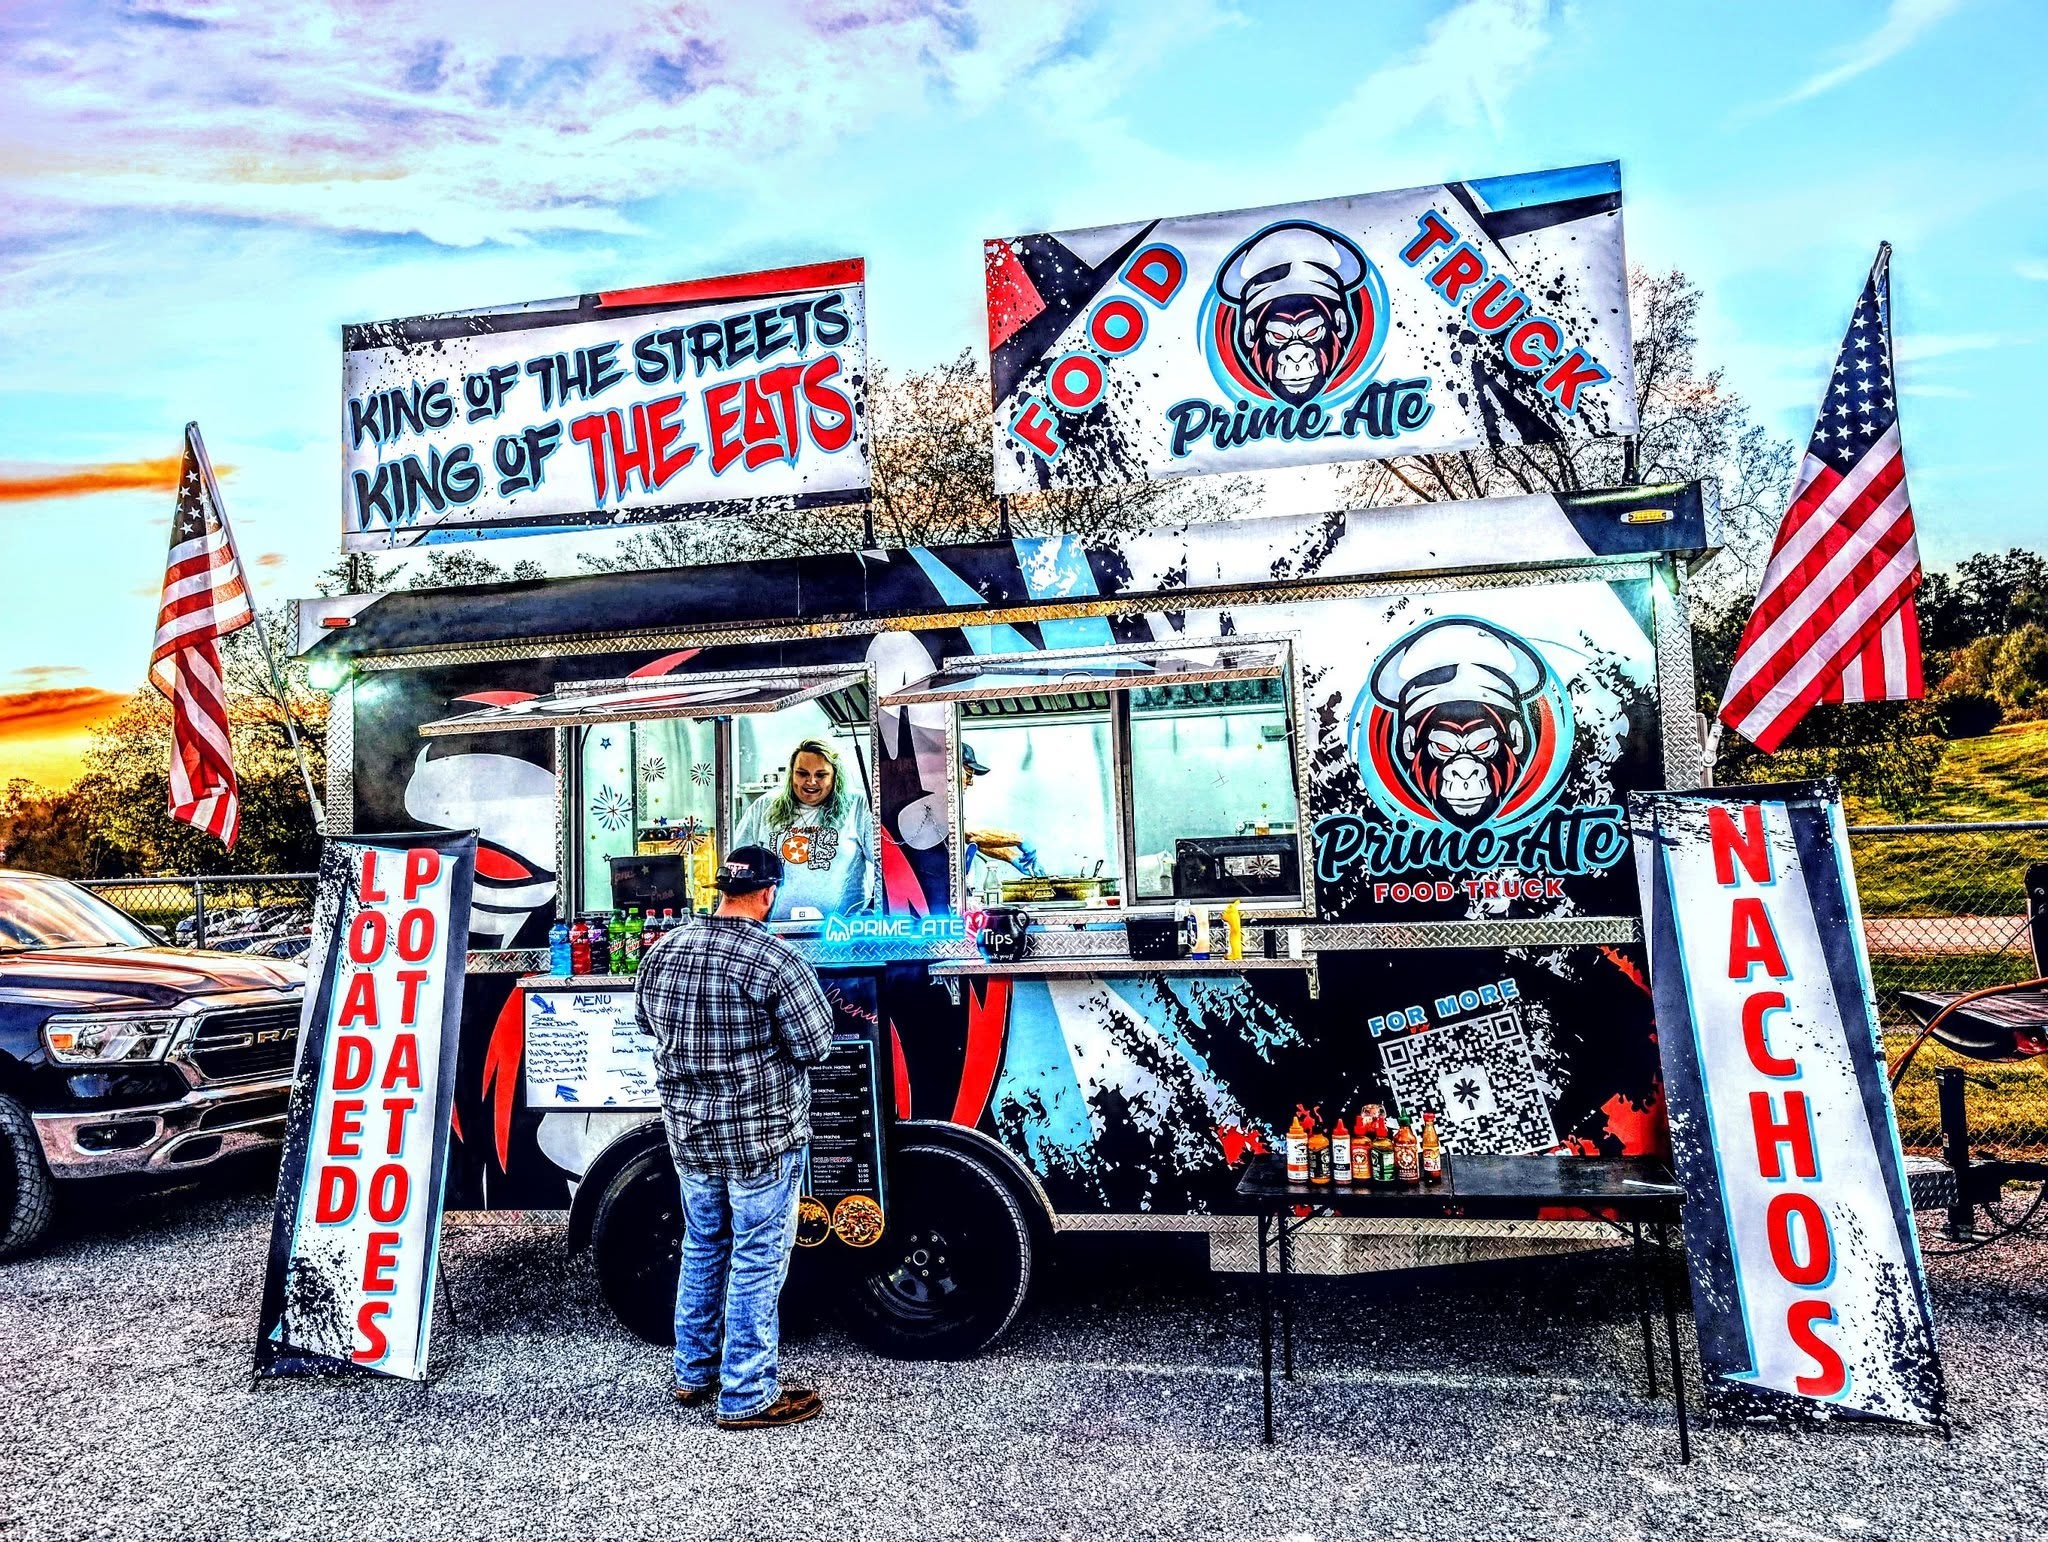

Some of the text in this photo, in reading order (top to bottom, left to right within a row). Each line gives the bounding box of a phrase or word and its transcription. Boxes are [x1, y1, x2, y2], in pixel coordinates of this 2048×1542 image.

[349, 291, 853, 457] KING OF THE STREETS
[1009, 241, 1187, 462] FOOD
[1399, 210, 1611, 415] TRUCK
[352, 353, 856, 535] KING OF THE EATS
[983, 928, 1013, 951] Tips
[1374, 878, 1565, 903] FOOD TRUCK
[316, 851, 386, 1224] LOADED
[573, 994, 612, 1007] MENU
[824, 981, 878, 1025] Menu
[1368, 978, 1519, 1037] FOR MORE
[352, 847, 440, 1366] POTATOES
[1708, 804, 1852, 1401] NACHOS
